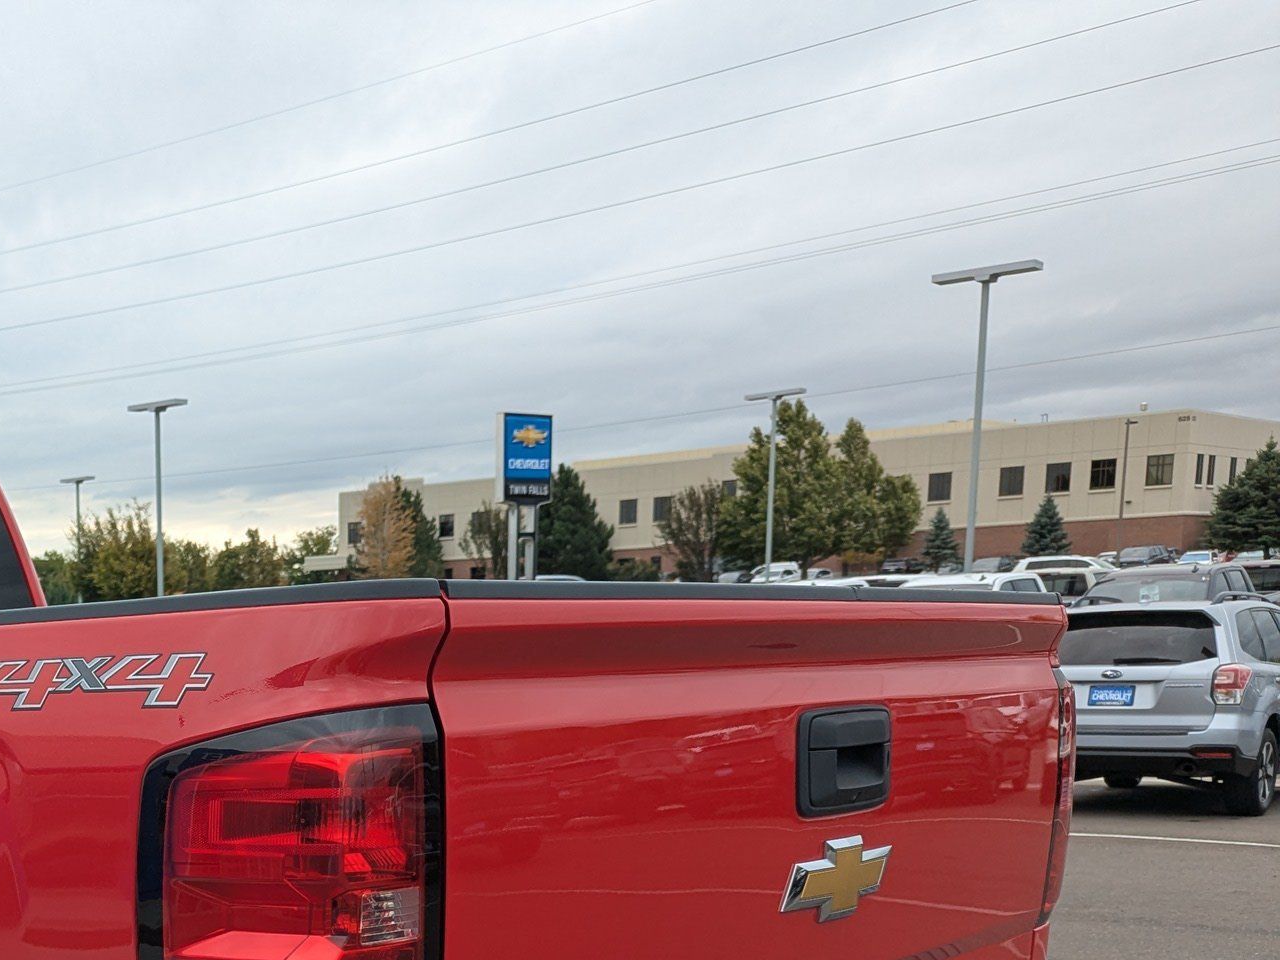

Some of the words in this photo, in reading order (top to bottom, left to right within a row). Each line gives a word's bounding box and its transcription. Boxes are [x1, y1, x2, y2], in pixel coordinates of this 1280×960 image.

[508, 458, 550, 470] CHEVROLET
[509, 484, 527, 496] TWIN
[528, 484, 549, 496] FALLS
